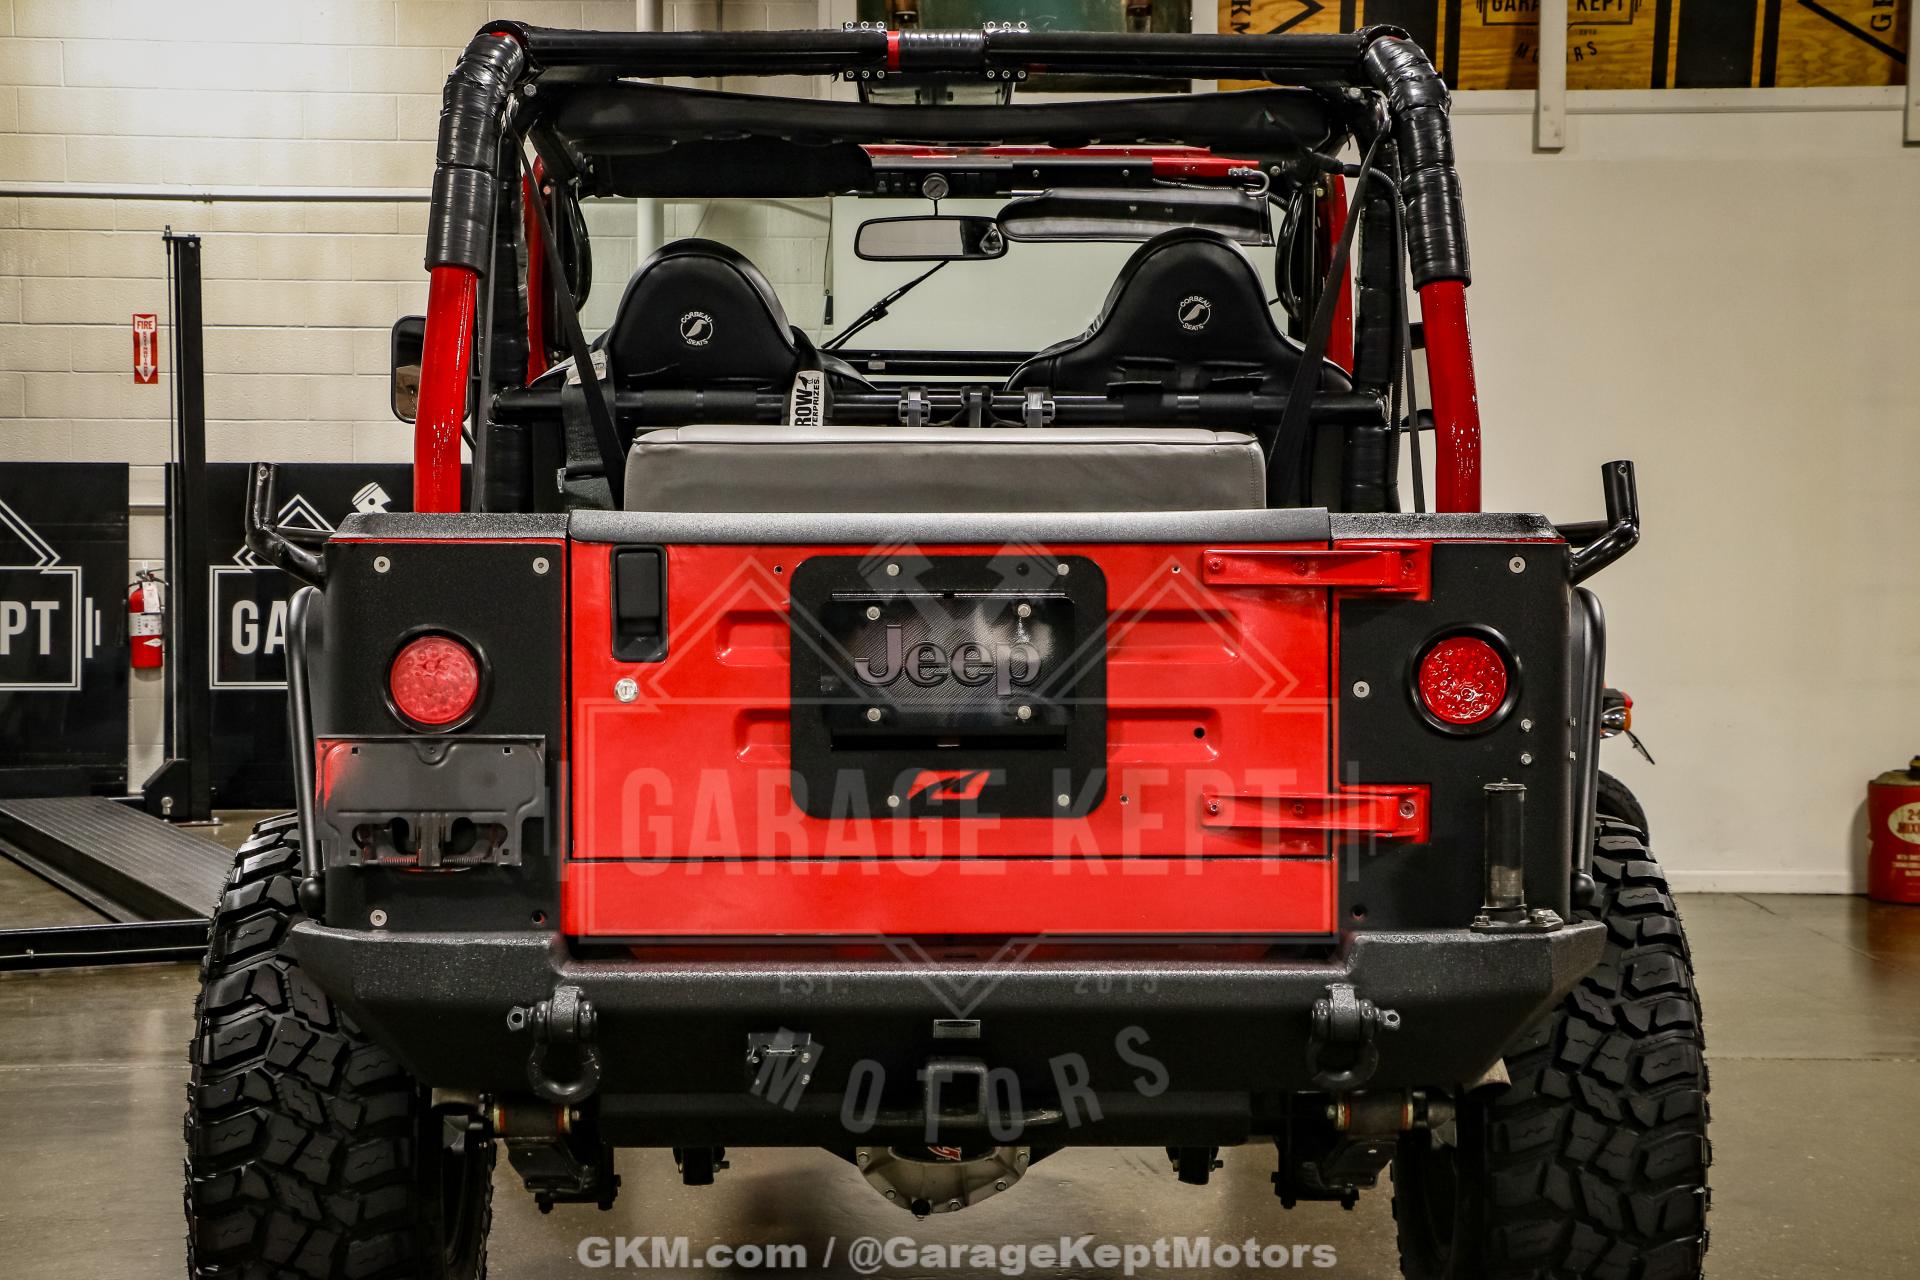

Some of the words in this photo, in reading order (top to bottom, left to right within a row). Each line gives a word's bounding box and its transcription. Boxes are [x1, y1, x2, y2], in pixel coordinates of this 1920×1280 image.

[1180, 295, 1212, 308] CORBEAU
[680, 311, 713, 324] CORBEAU
[137, 320, 153, 330] FIRE
[1183, 322, 1204, 331] SEATS
[686, 337, 709, 346] SEATS
[854, 623, 1043, 697] Jeep
